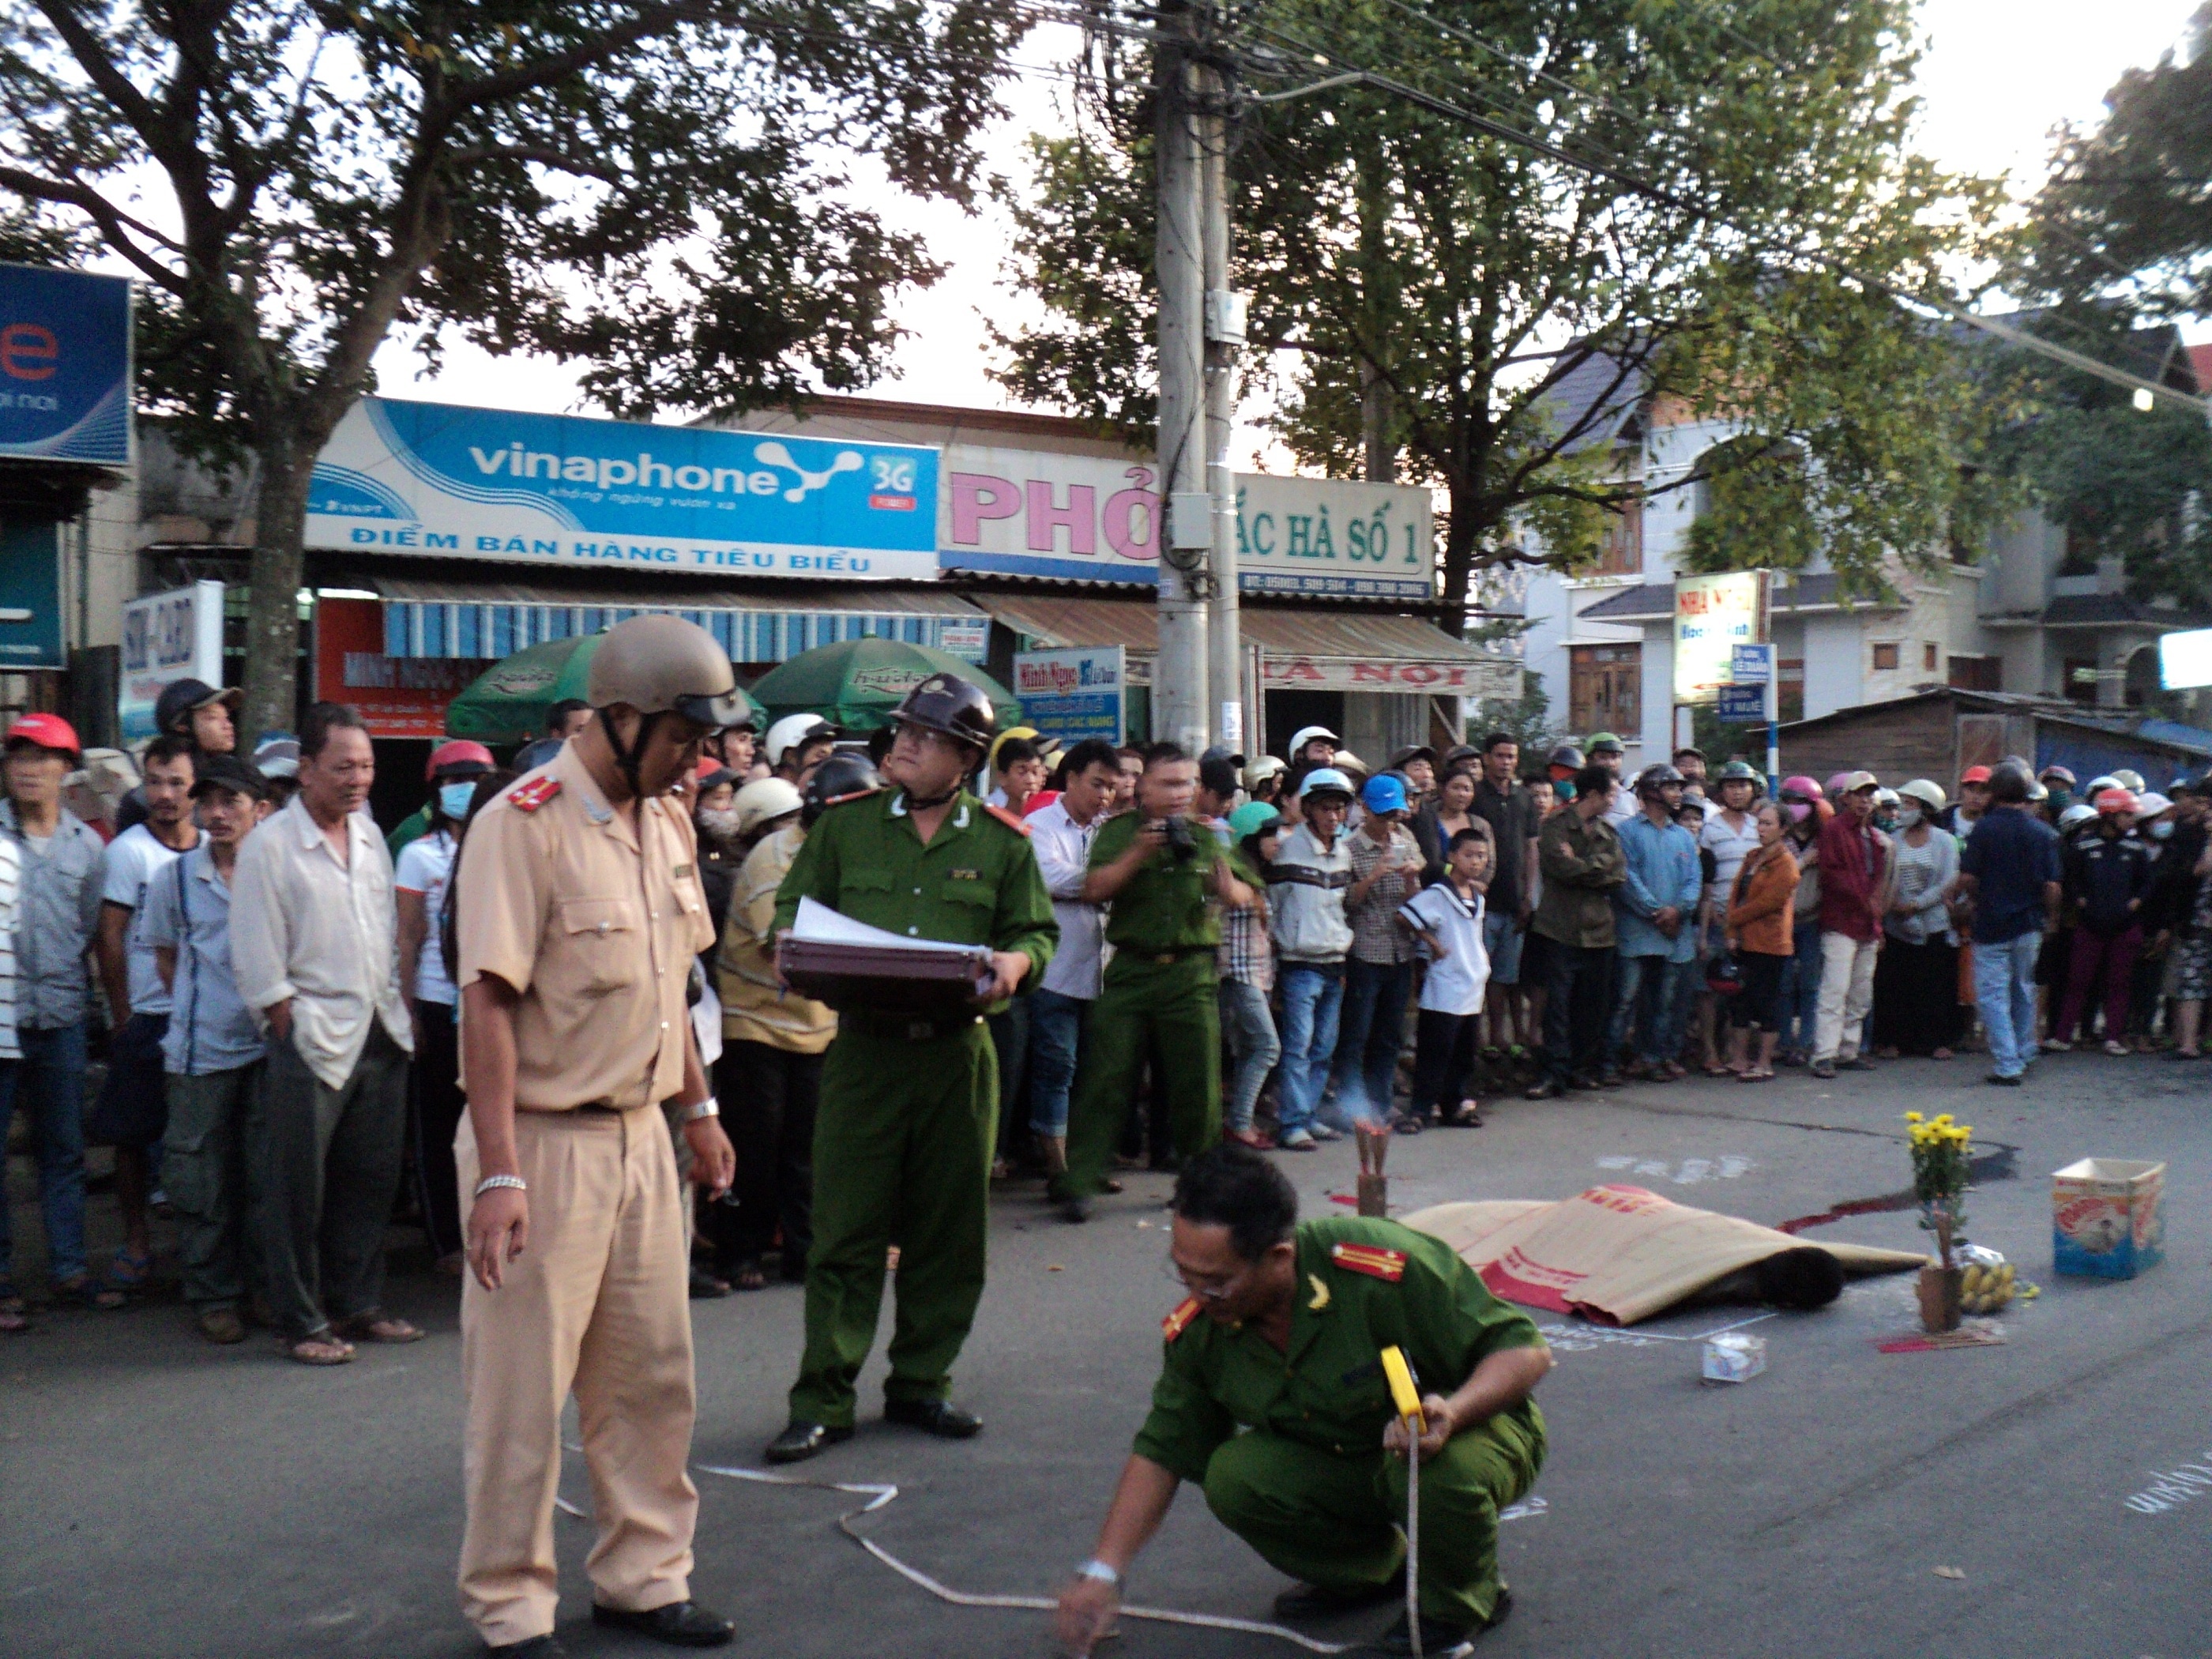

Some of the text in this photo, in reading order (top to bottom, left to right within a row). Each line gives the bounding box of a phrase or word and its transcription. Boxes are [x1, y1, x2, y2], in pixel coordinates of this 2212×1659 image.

[468, 442, 780, 497] vinaphone
[874, 460, 913, 493] 3G
[350, 523, 871, 573] ĐIỂM BÁN HÀNG TIÊU BIỂU
[1286, 502, 1336, 559] HÀ
[1348, 499, 1392, 562] SỐ
[1403, 522, 1418, 564] 1
